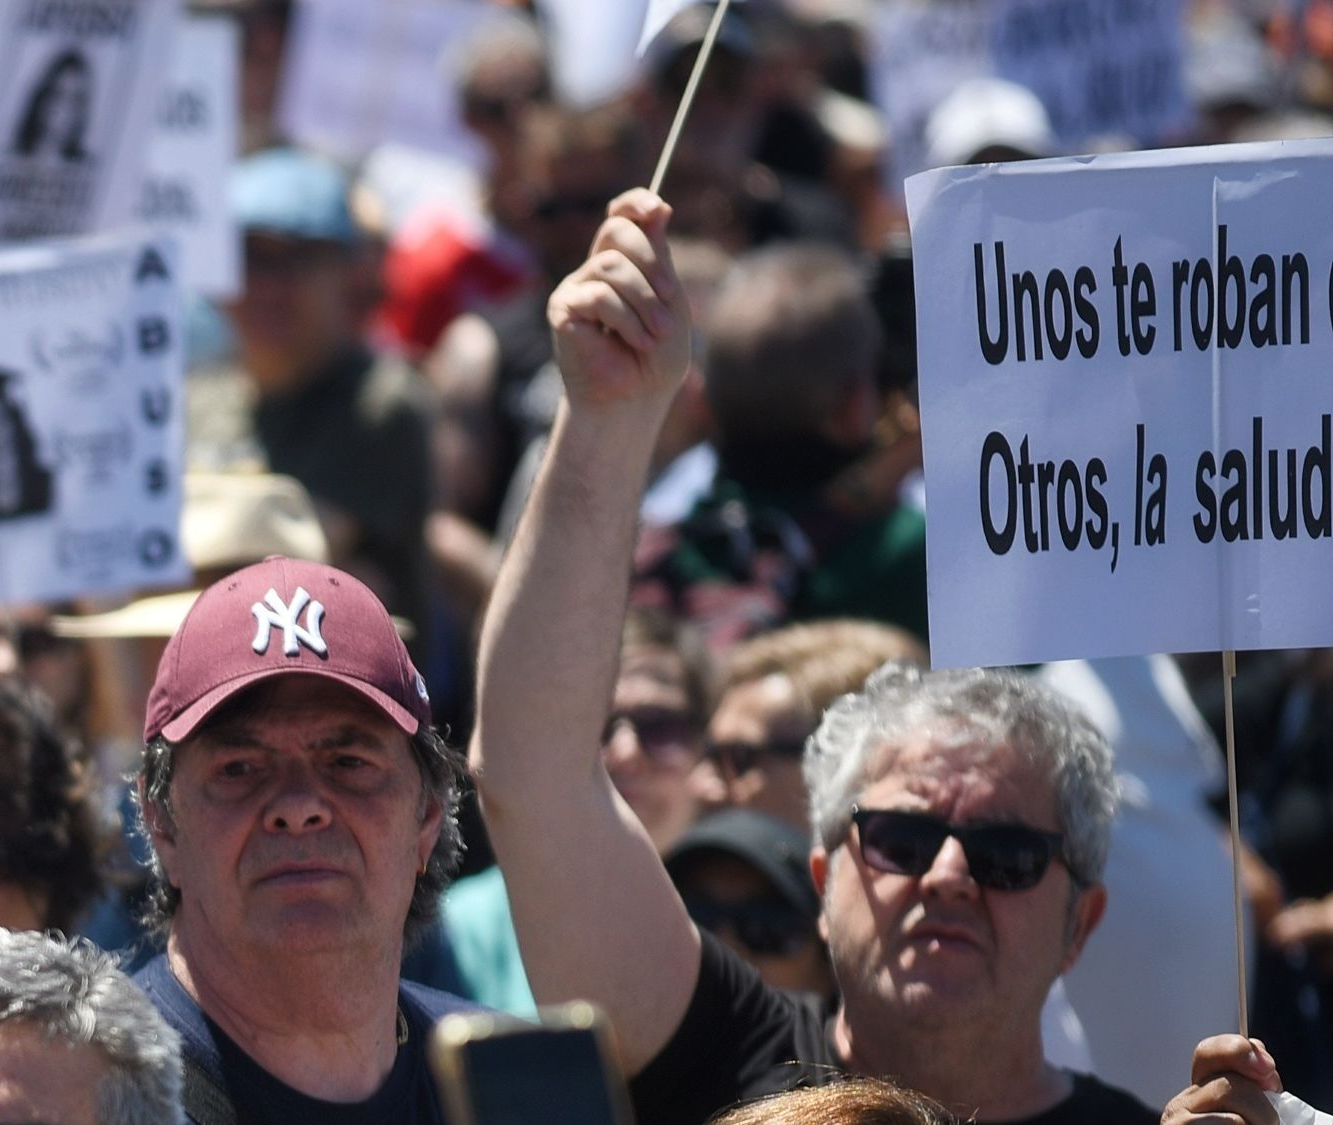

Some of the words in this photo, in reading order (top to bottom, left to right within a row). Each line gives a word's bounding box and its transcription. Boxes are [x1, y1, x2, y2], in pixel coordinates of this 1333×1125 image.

[973, 241, 1101, 366] Unos
[1112, 234, 1157, 357] te
[1172, 225, 1310, 352] roban
[979, 430, 1120, 574] Otros,
[1133, 423, 1168, 547] la
[1192, 413, 1333, 545] salud
[251, 586, 329, 661] NY
